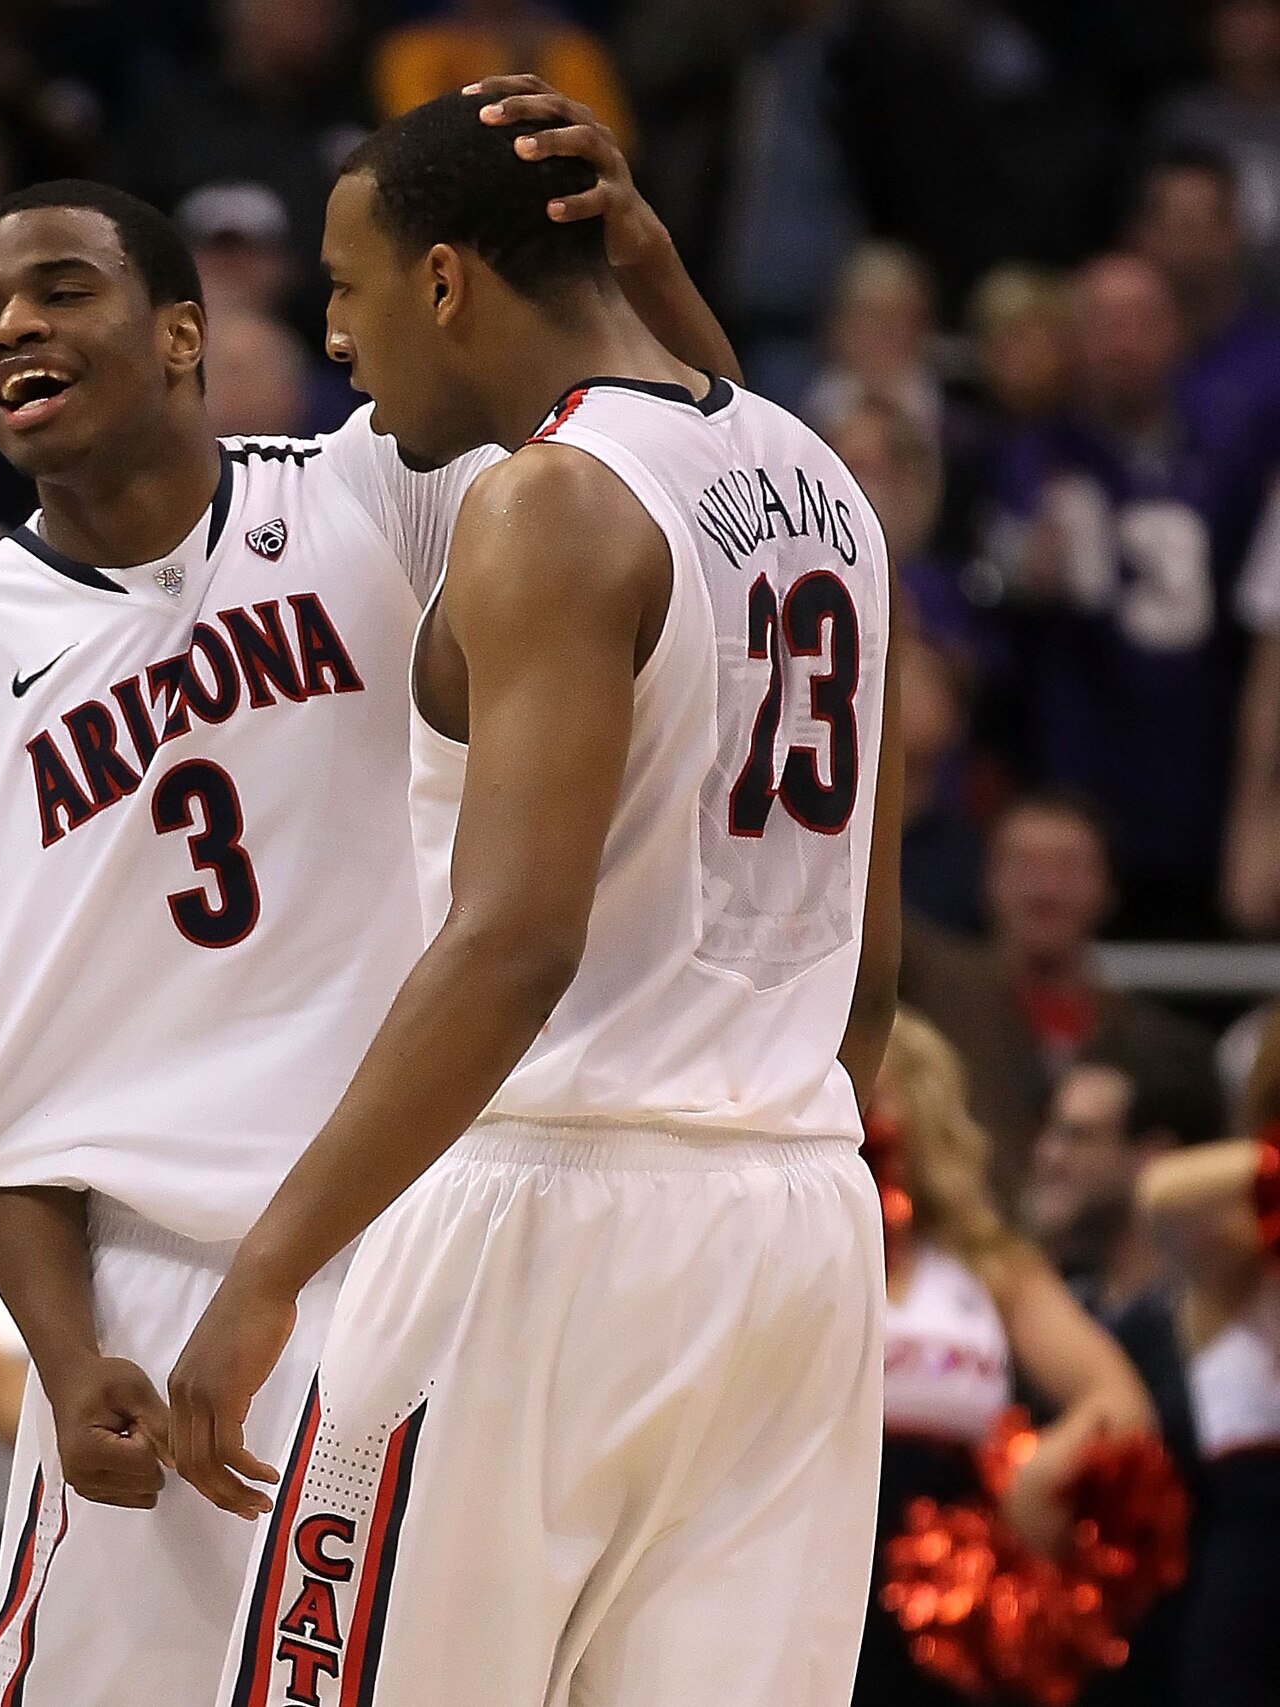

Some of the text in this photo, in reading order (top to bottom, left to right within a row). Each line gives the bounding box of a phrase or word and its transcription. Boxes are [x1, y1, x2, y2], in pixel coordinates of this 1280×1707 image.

[25, 592, 366, 849] ARIZONA
[729, 568, 860, 839] 23
[151, 757, 261, 949] 3
[276, 1512, 357, 1707] CAT
